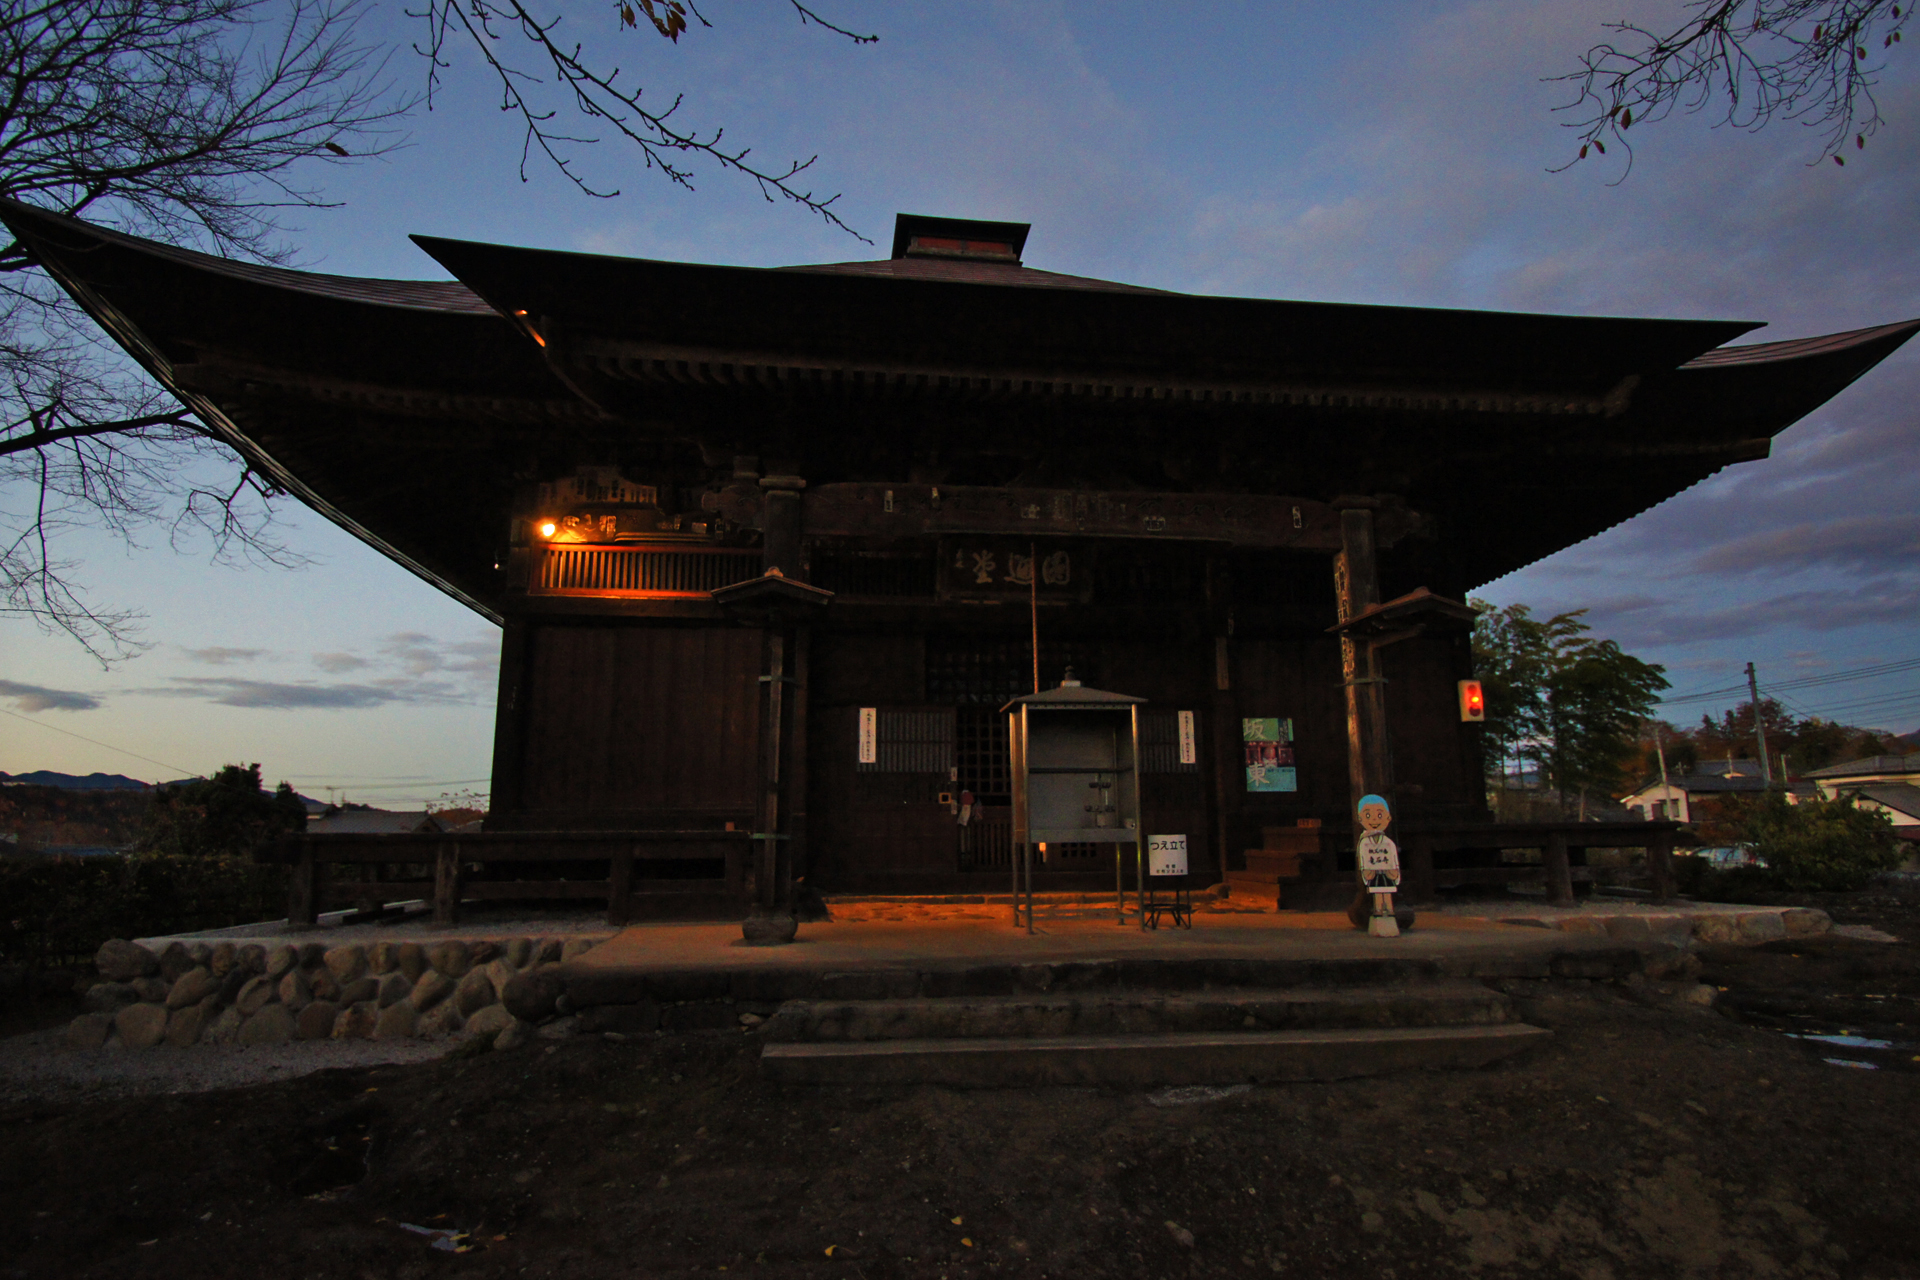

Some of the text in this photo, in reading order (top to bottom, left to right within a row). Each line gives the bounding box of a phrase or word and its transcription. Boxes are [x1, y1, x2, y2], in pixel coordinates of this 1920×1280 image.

[1248, 761, 1270, 787] 東
[1150, 841, 1185, 850] つえ立て
